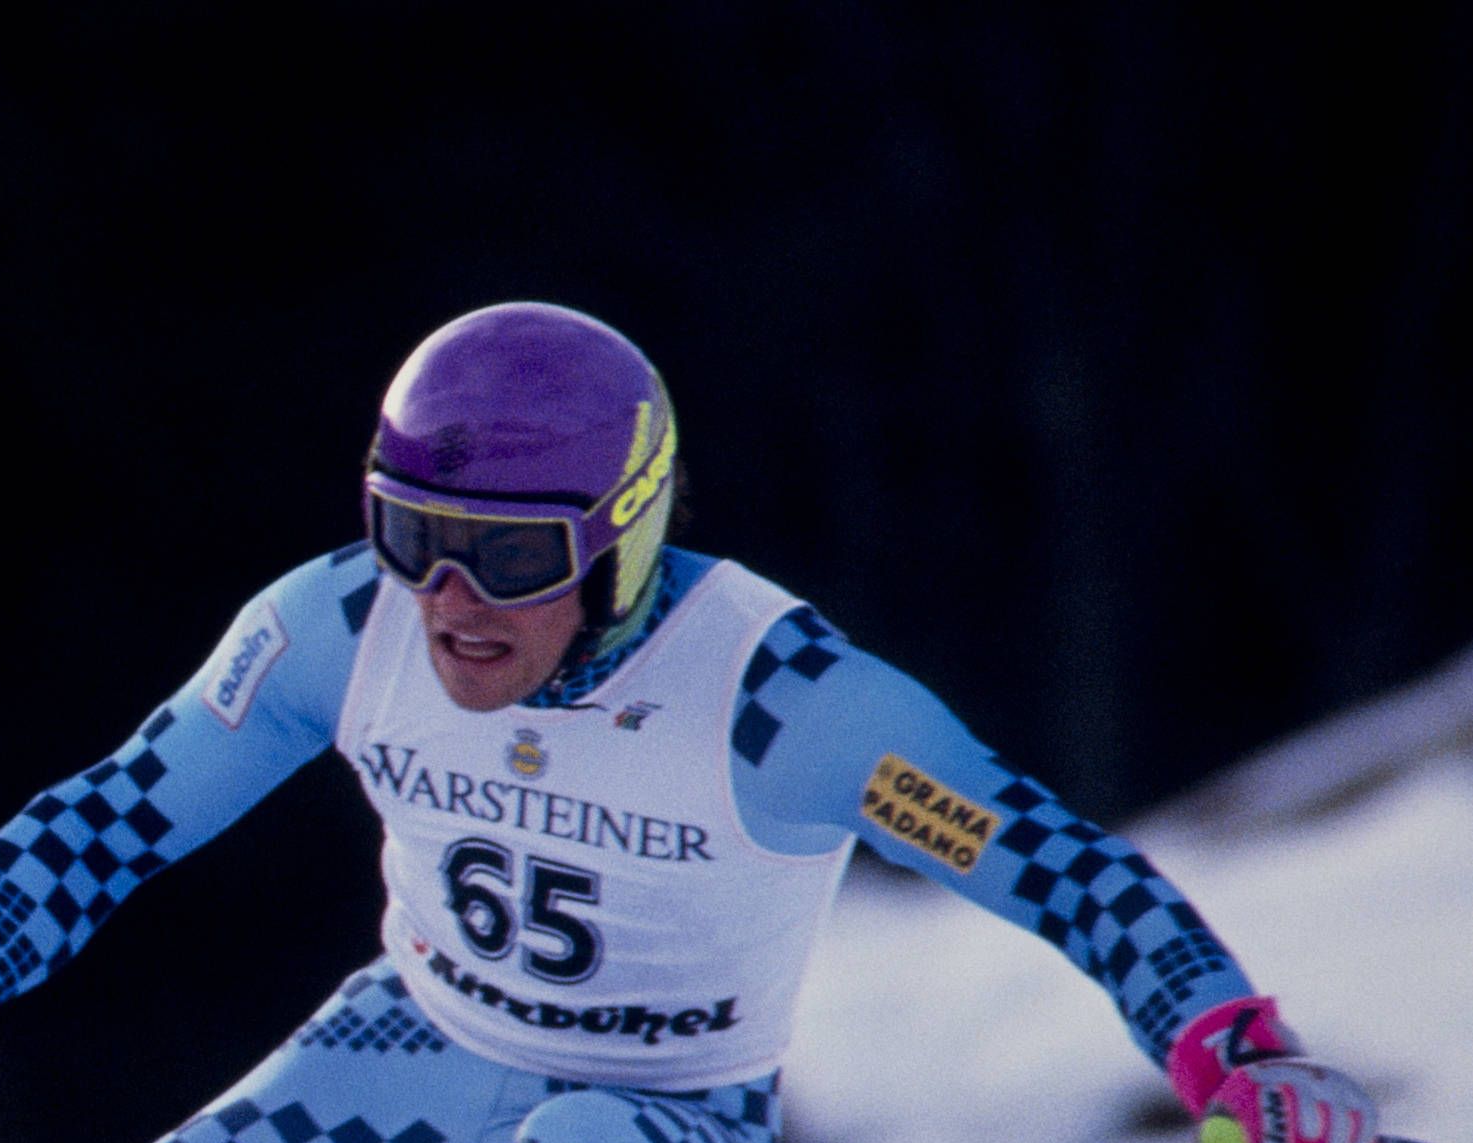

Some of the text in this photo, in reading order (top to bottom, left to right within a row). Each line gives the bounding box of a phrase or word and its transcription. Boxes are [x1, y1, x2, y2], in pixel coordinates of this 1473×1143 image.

[217, 627, 271, 708] dubin
[360, 743, 714, 863] WARSTEINER
[862, 789, 976, 869] PADANO
[893, 770, 991, 842] GRANA
[439, 837, 604, 986] 65
